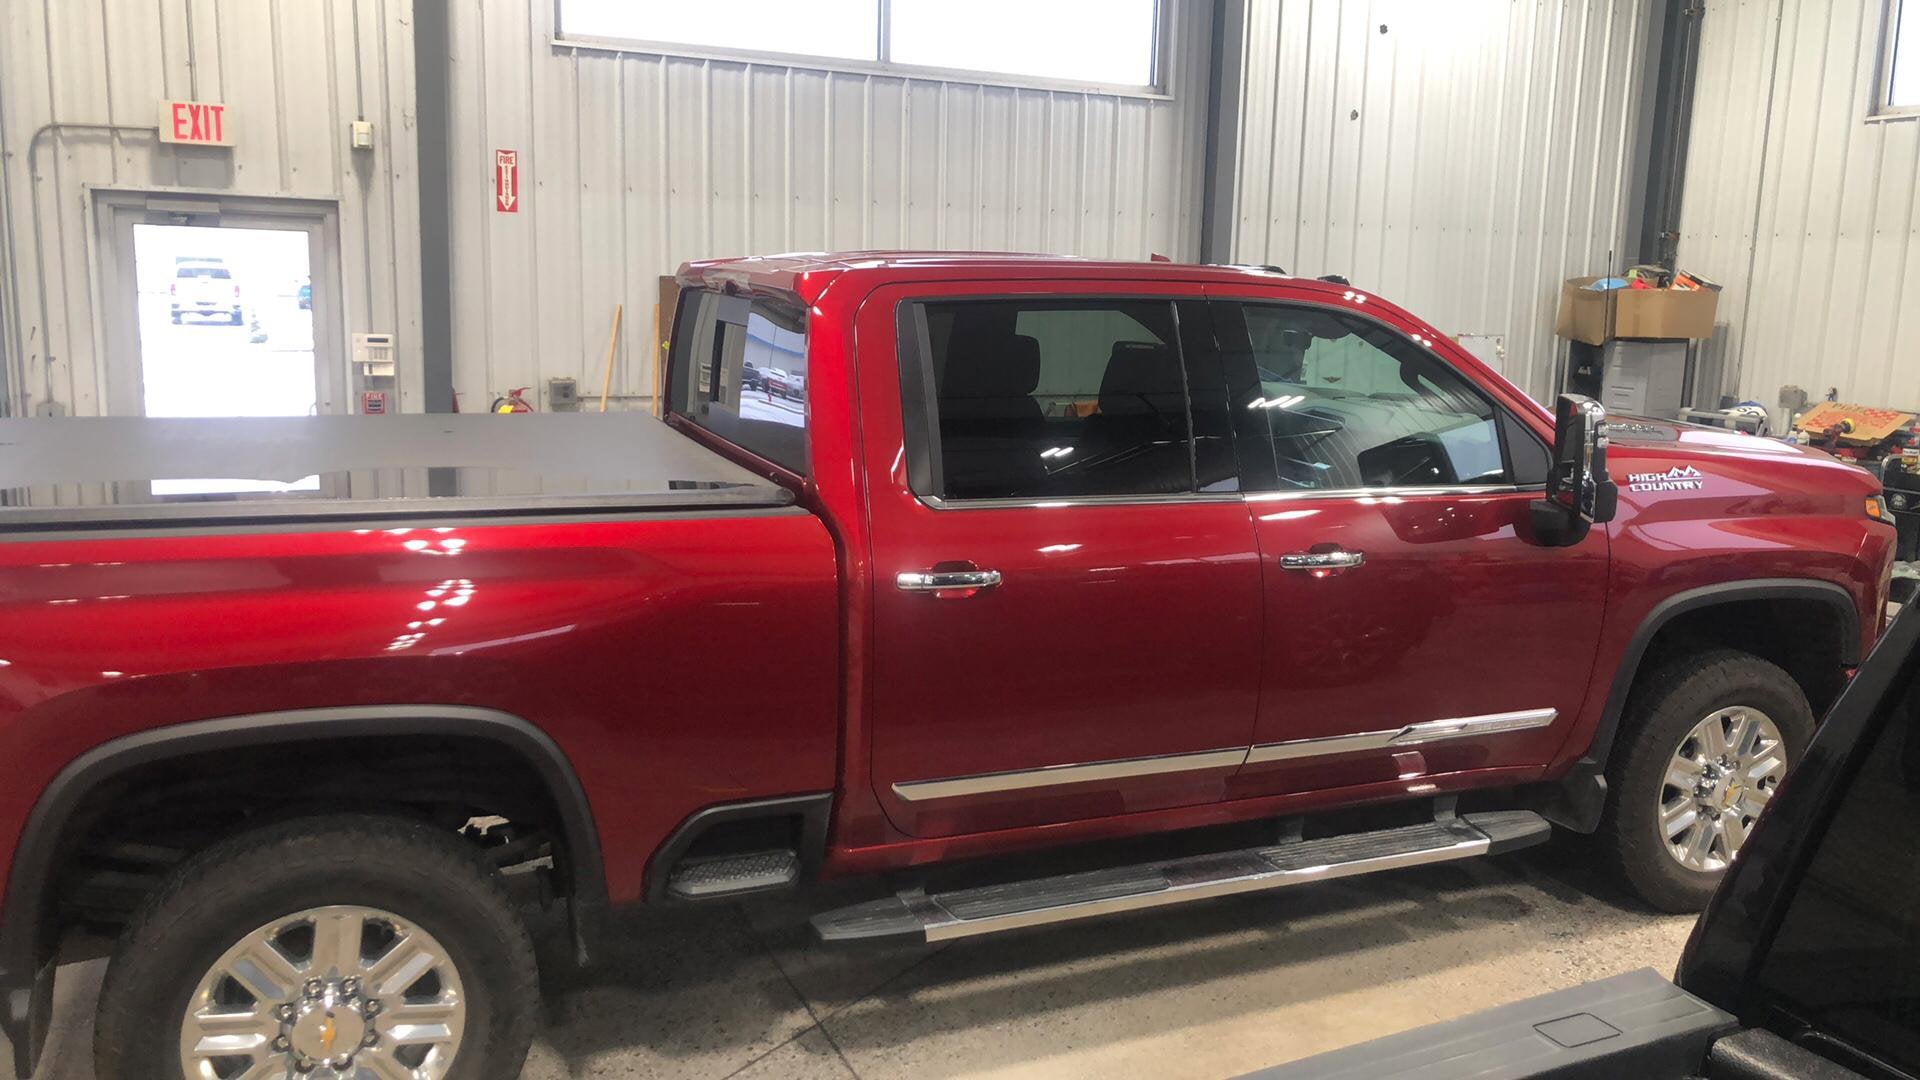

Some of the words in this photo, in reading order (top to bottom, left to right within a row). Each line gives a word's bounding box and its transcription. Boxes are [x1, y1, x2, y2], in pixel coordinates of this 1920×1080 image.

[172, 103, 224, 142] EXIT
[499, 155, 514, 165] FIRE
[1628, 473, 1668, 482] HIGH
[1629, 481, 1703, 492] COUNTRY
